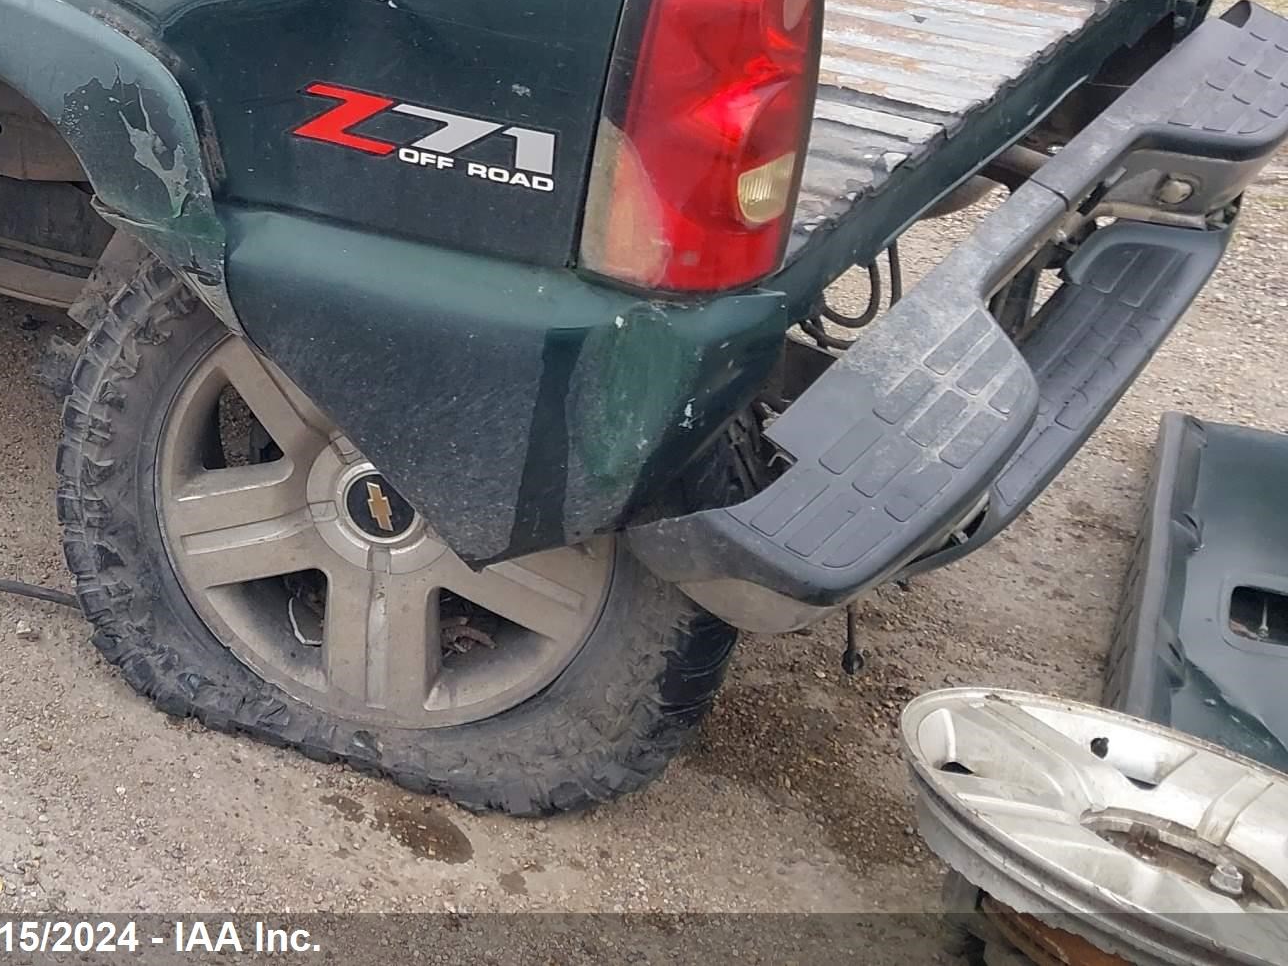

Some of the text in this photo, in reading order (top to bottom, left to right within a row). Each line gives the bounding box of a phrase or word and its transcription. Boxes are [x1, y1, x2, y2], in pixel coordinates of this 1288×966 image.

[293, 82, 556, 175] Z71
[398, 147, 555, 192] OFF ROAD
